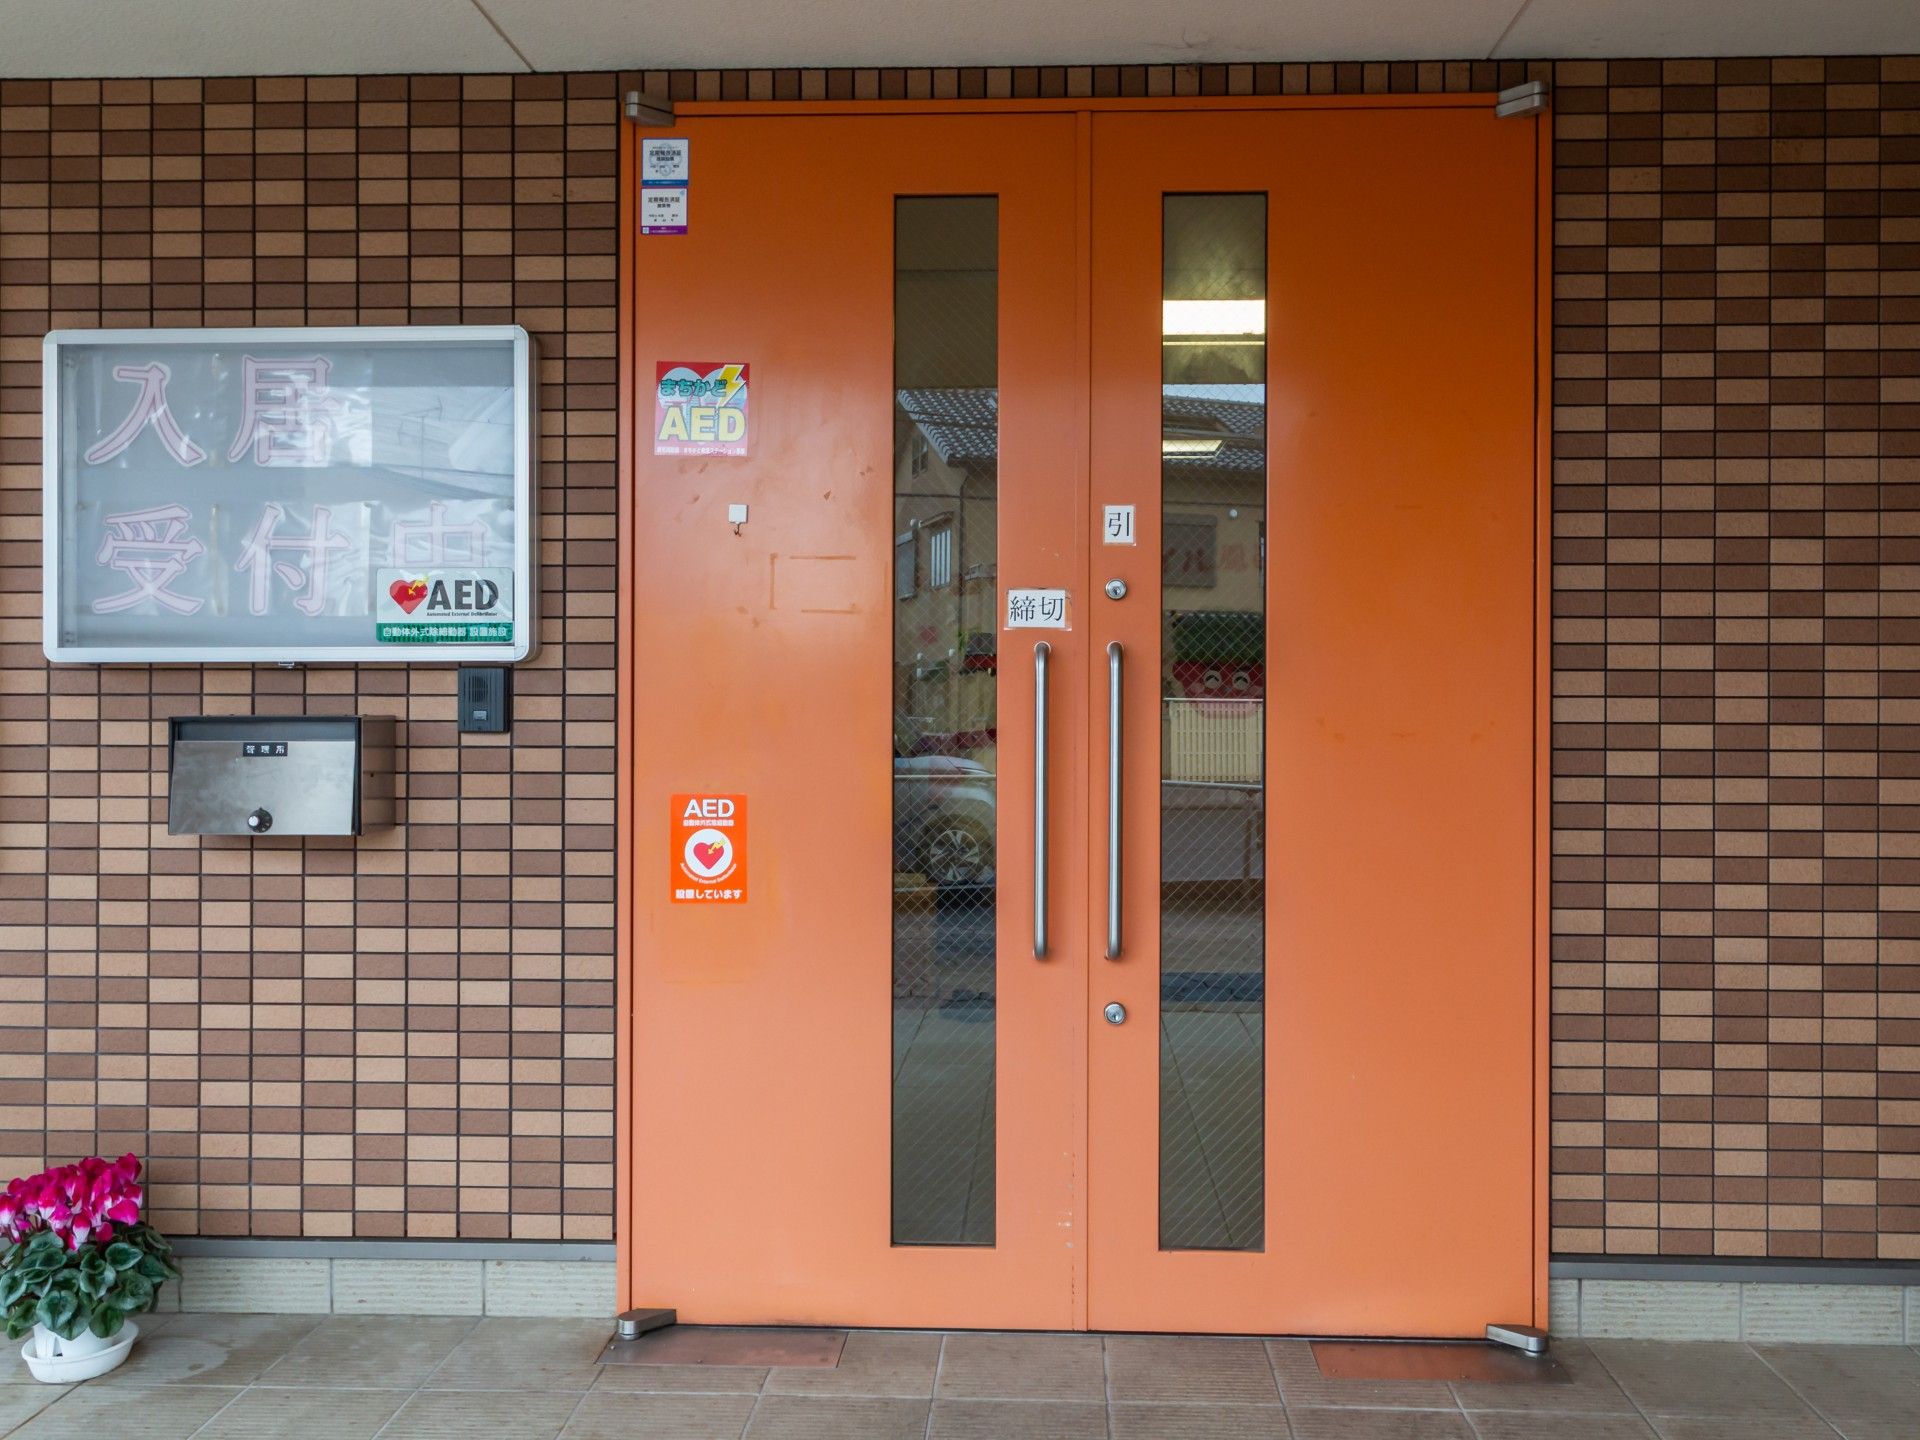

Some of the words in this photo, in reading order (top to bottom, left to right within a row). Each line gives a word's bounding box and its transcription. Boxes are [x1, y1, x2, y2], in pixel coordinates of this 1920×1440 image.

[660, 378, 728, 397] まちかど
[84, 355, 340, 467] 入居
[659, 405, 746, 442] AED
[1108, 511, 1131, 537] 引
[92, 502, 488, 615] 受付中
[427, 580, 499, 610] AED
[1009, 595, 1064, 622] 締切
[383, 626, 467, 637] 自動体外式除細動器
[469, 626, 507, 637] 設置施設
[683, 799, 735, 817] AED
[675, 889, 743, 899] 設置しています
